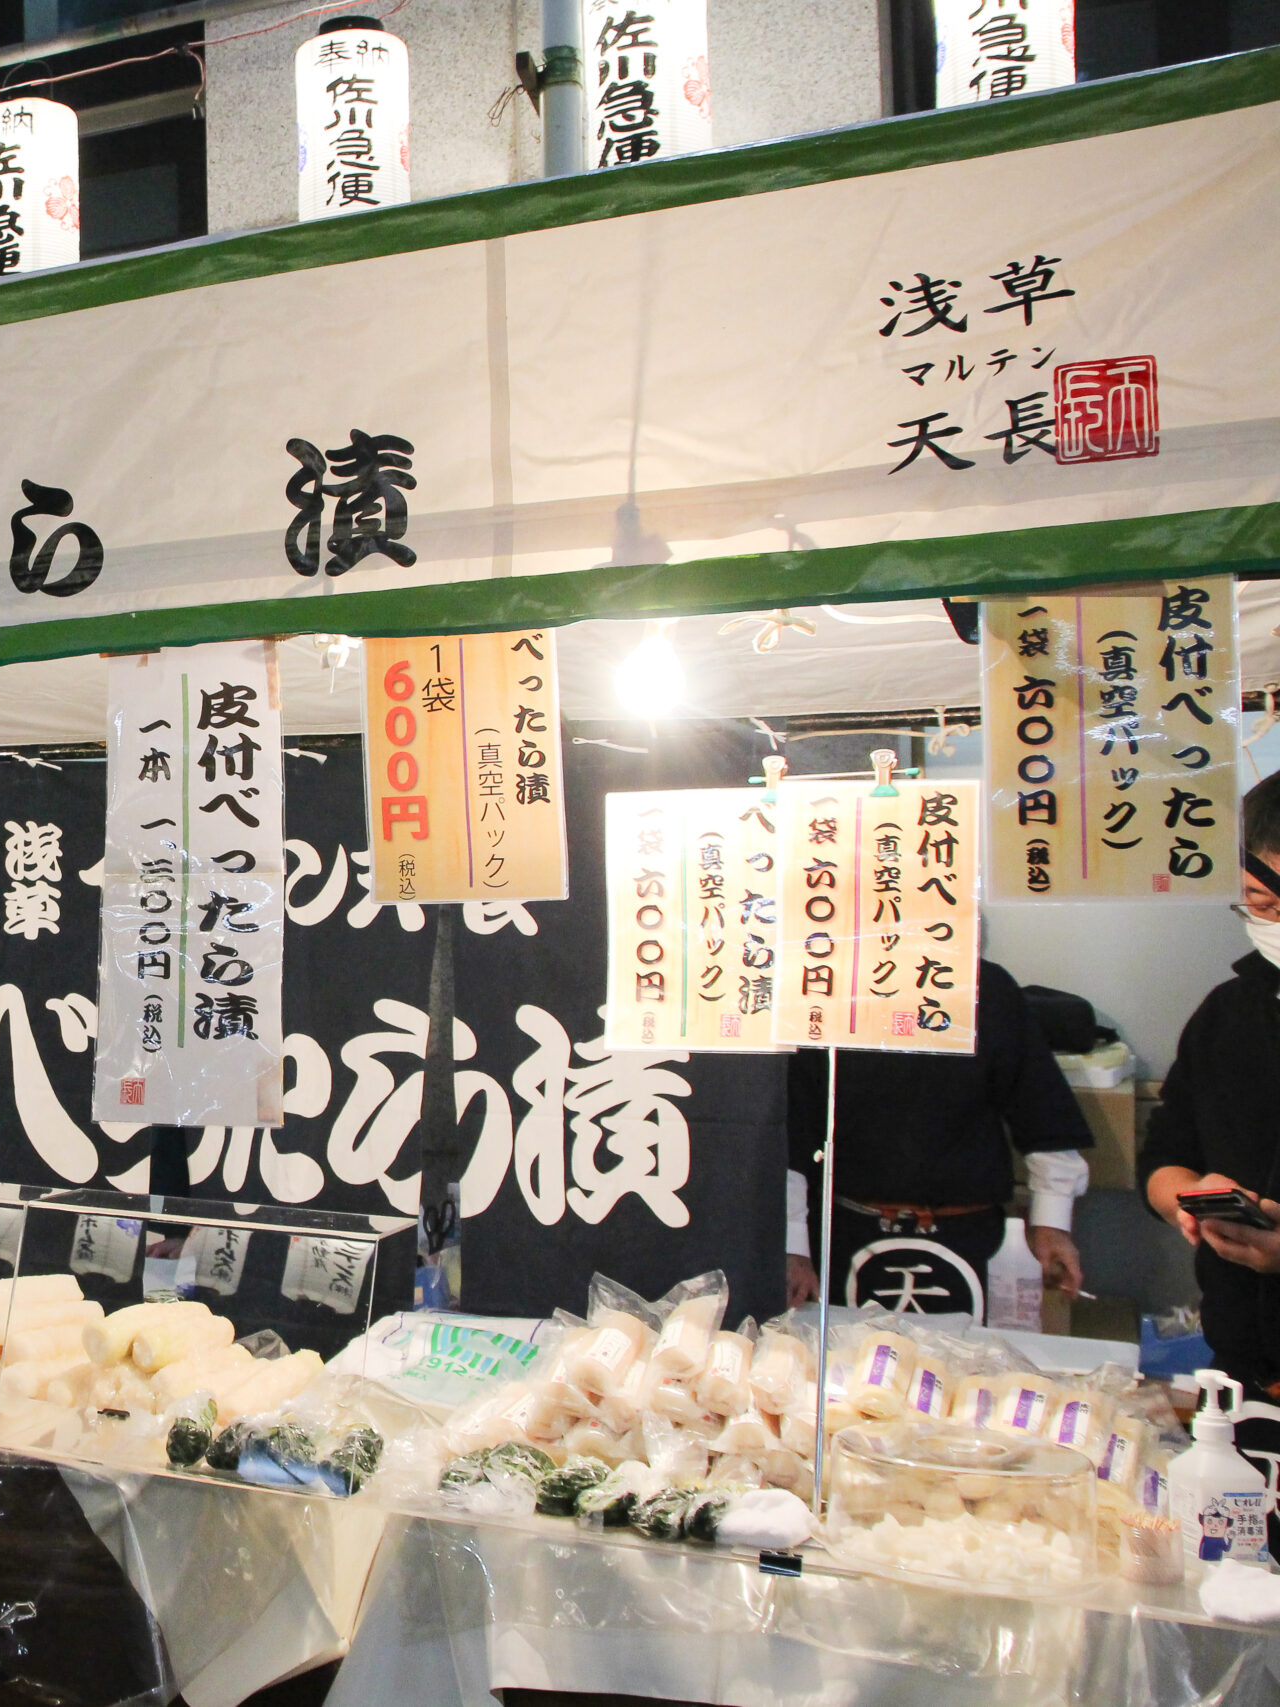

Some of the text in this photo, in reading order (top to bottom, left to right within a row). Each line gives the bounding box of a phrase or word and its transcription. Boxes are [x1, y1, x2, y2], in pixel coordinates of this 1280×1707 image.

[324, 73, 381, 207] 佐川急便
[879, 254, 1076, 338] 浅草
[901, 346, 1057, 387] マルテン
[886, 390, 1058, 476] 天長
[381, 659, 430, 842] 600円
[421, 644, 456, 713] 1袋
[511, 634, 551, 806] べったら漬
[1096, 630, 1143, 850] （真空パック）
[1157, 585, 1216, 879] 皮付べったら
[3, 820, 64, 941] 浅草
[193, 681, 261, 1042] 皮付べったら漬
[474, 727, 510, 890] （真空パック）
[697, 831, 726, 1002] （真空パック）
[869, 822, 905, 998] （真空パック）
[916, 791, 960, 1032] 皮付べったら
